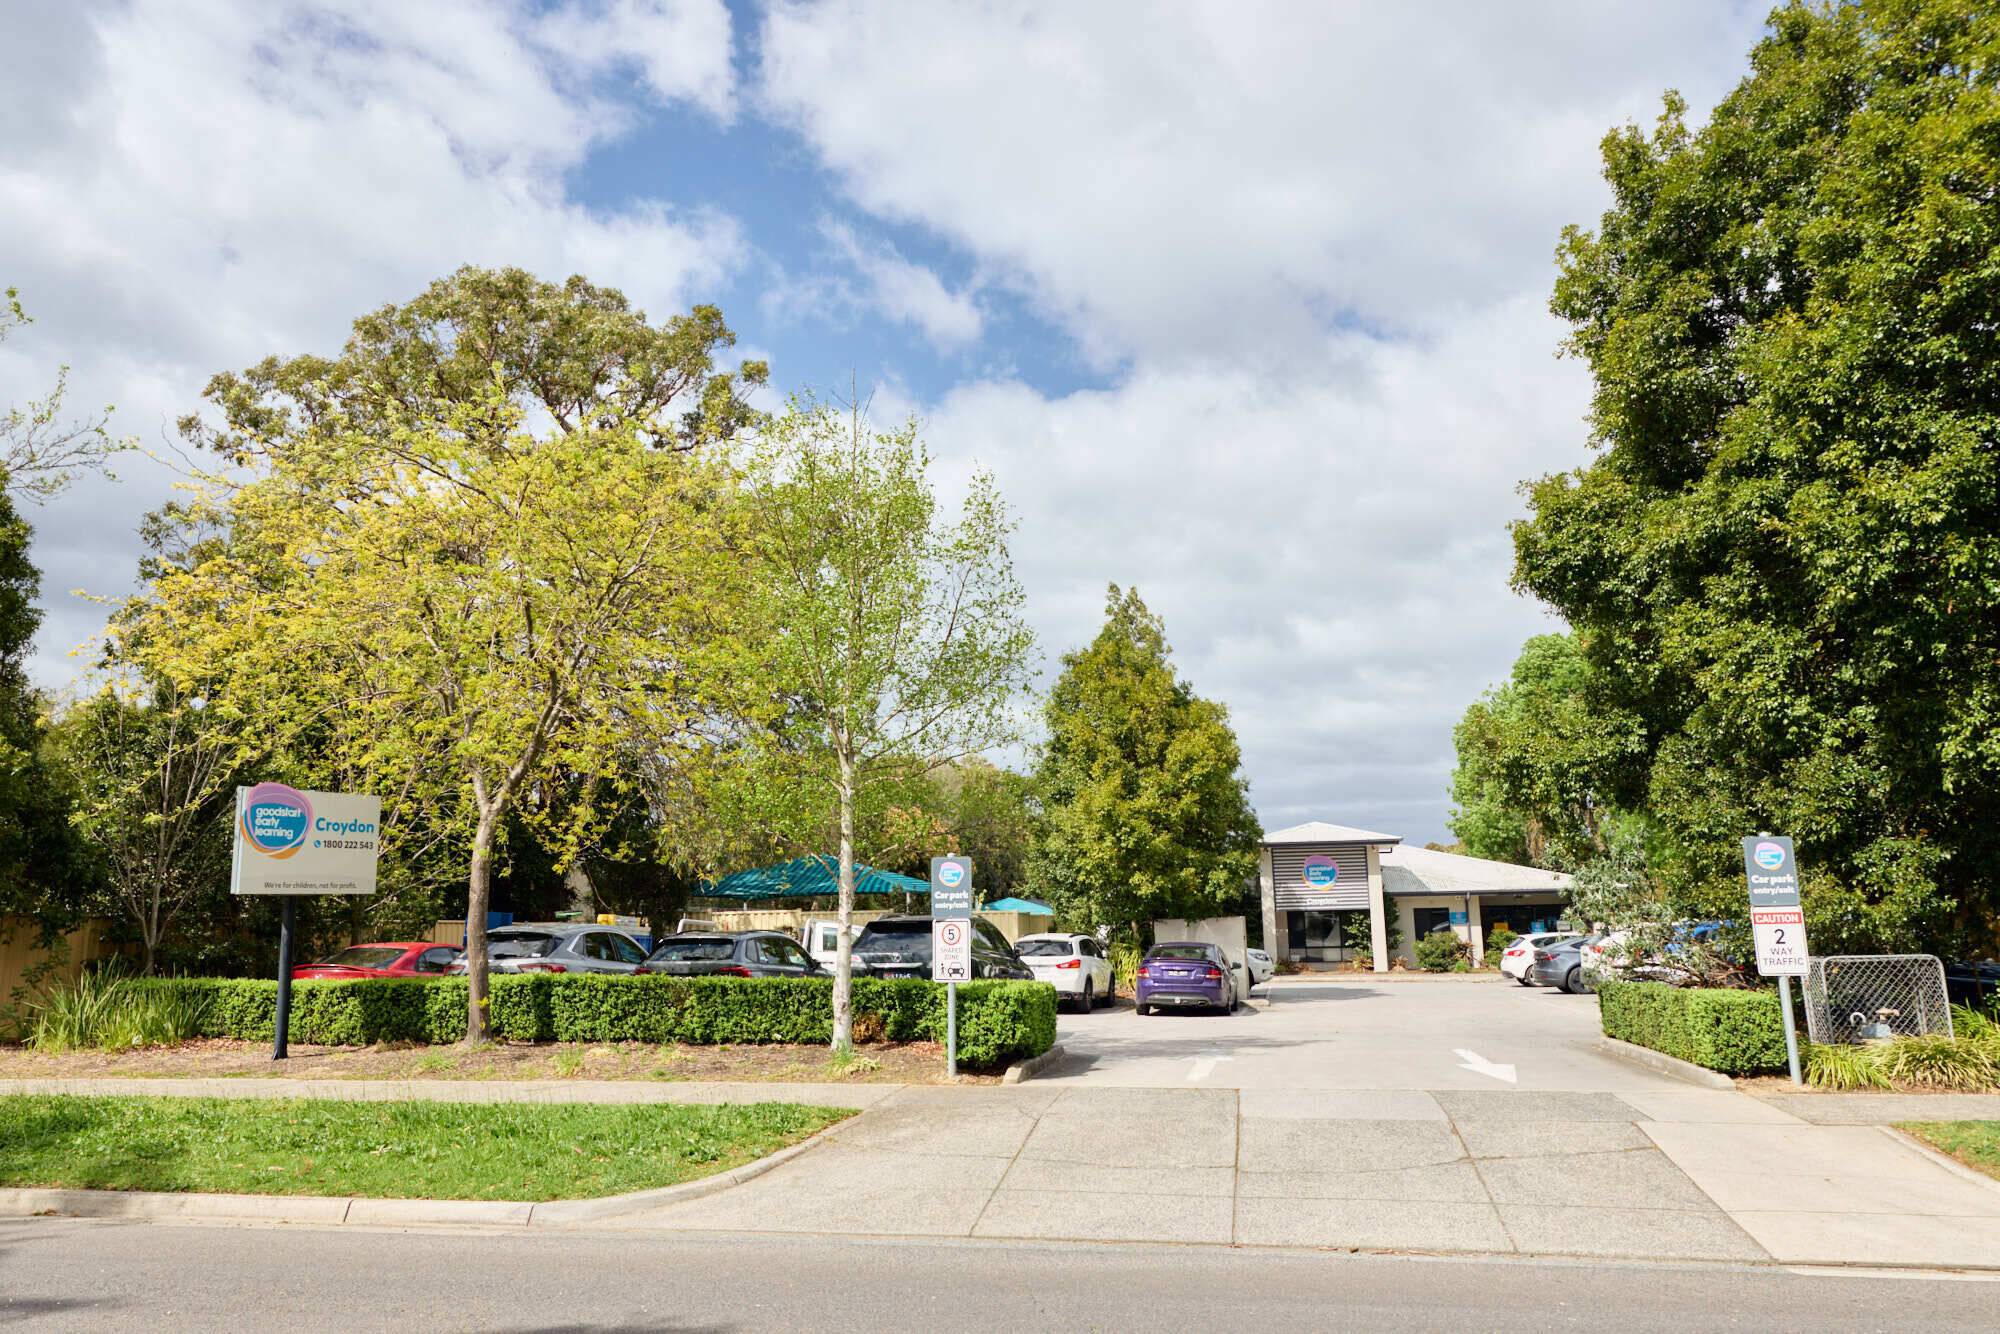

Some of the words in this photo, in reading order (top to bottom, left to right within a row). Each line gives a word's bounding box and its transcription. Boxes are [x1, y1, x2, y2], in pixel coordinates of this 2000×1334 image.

[255, 807, 302, 818] goodstart
[255, 816, 280, 829] early
[315, 817, 374, 836] Croydon
[254, 826, 294, 840] learning
[323, 840, 343, 849] 1800
[344, 840, 358, 849] 222
[359, 841, 374, 850] 543
[1751, 874, 1769, 884] Car
[1770, 873, 1794, 886] park
[934, 891, 948, 899] Car
[949, 890, 969, 901] park
[1755, 913, 1799, 923] CAUTION
[948, 928, 955, 941] 5
[1774, 928, 1786, 945] 2
[1771, 947, 1793, 955] WAY
[1763, 957, 1804, 966] TRAFFIC
